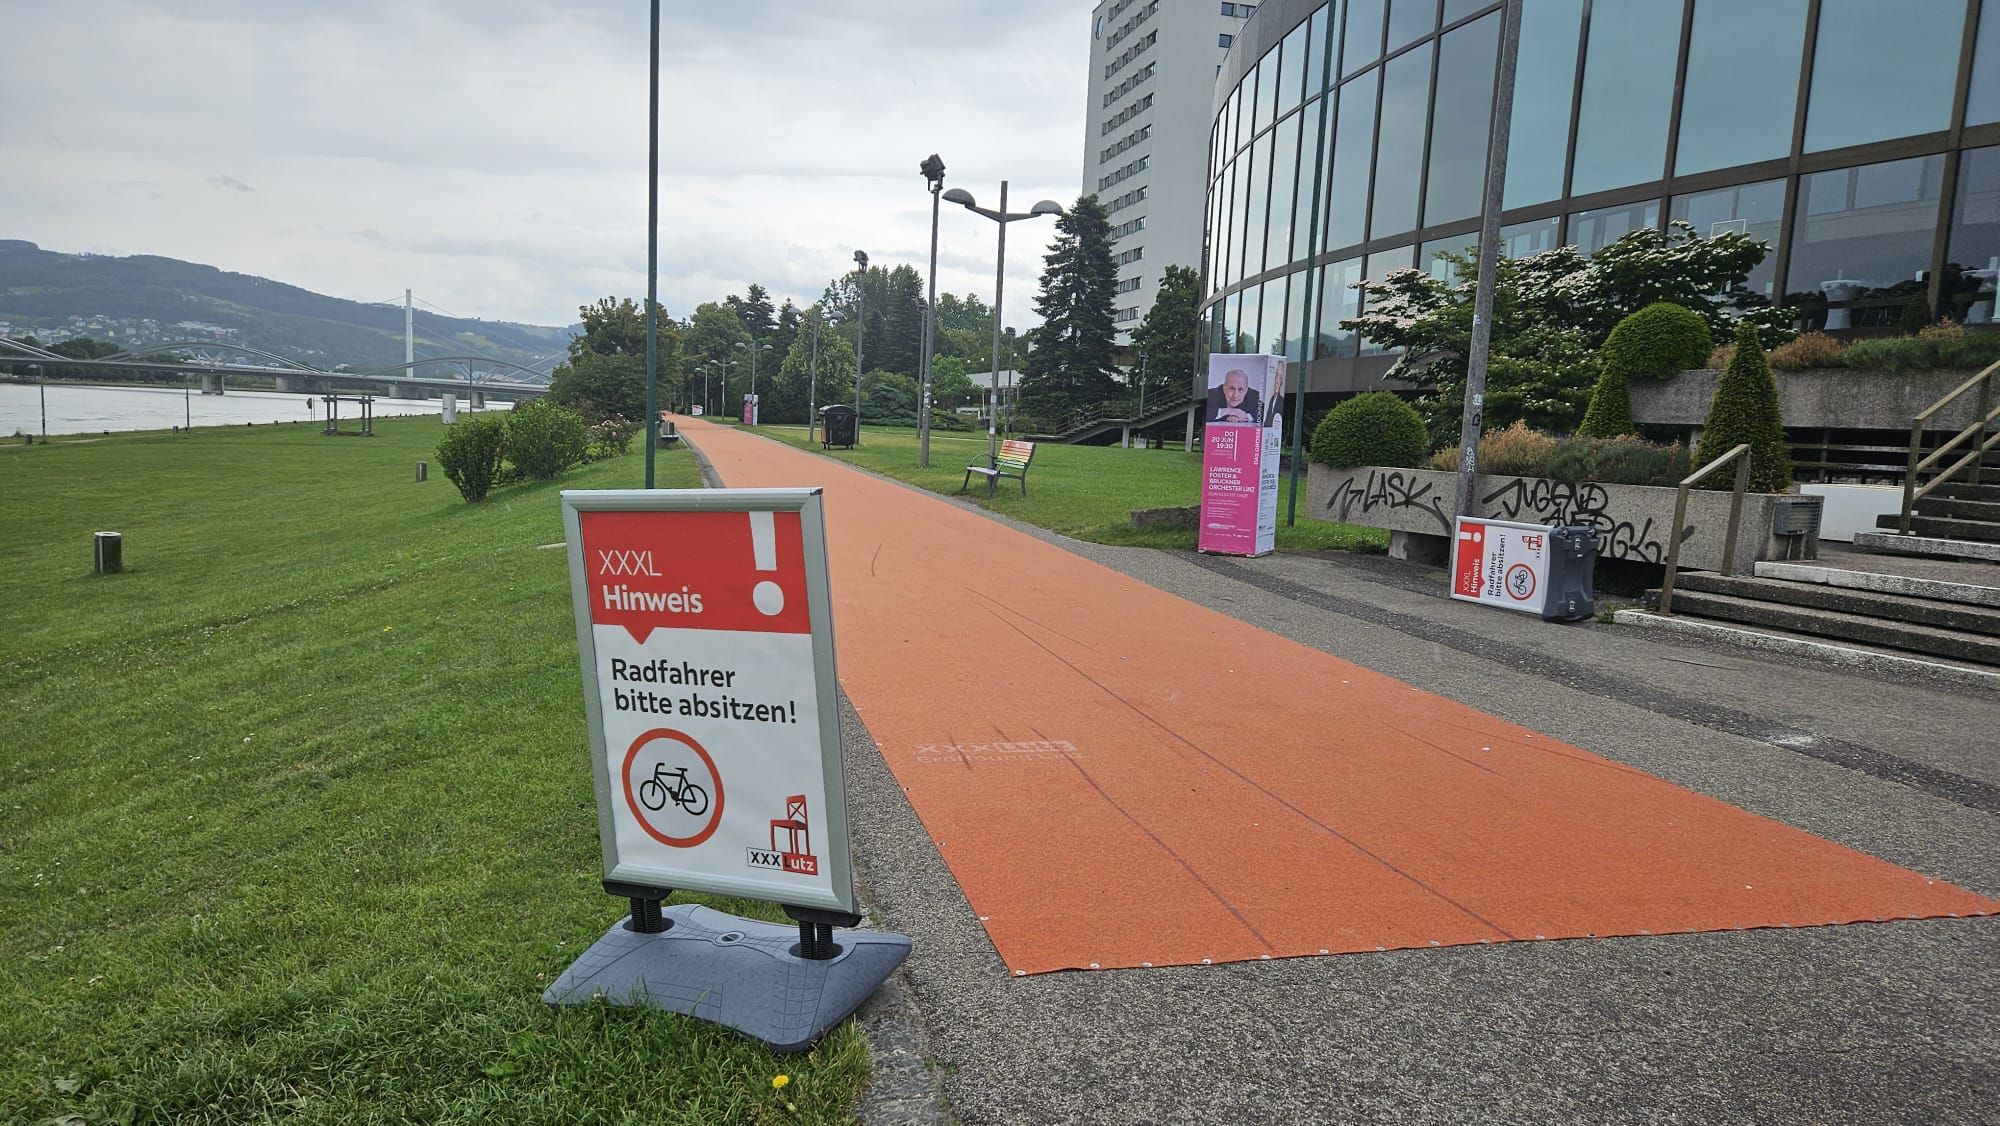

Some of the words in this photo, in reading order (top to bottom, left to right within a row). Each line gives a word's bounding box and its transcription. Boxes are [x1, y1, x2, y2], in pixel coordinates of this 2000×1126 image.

[1209, 478, 1241, 486] BRUCKNER
[598, 549, 662, 576] XXXL
[1497, 534, 1506, 575] absitzen!
[1463, 571, 1471, 592] XXXL
[1470, 558, 1480, 593] Hinweis
[1487, 552, 1497, 596] Radfahrer
[1494, 575, 1503, 597] bitte
[602, 584, 704, 613] Hinweis
[611, 657, 735, 688] Radfahrer
[614, 687, 673, 715] bitte
[678, 693, 797, 724] absitzen!
